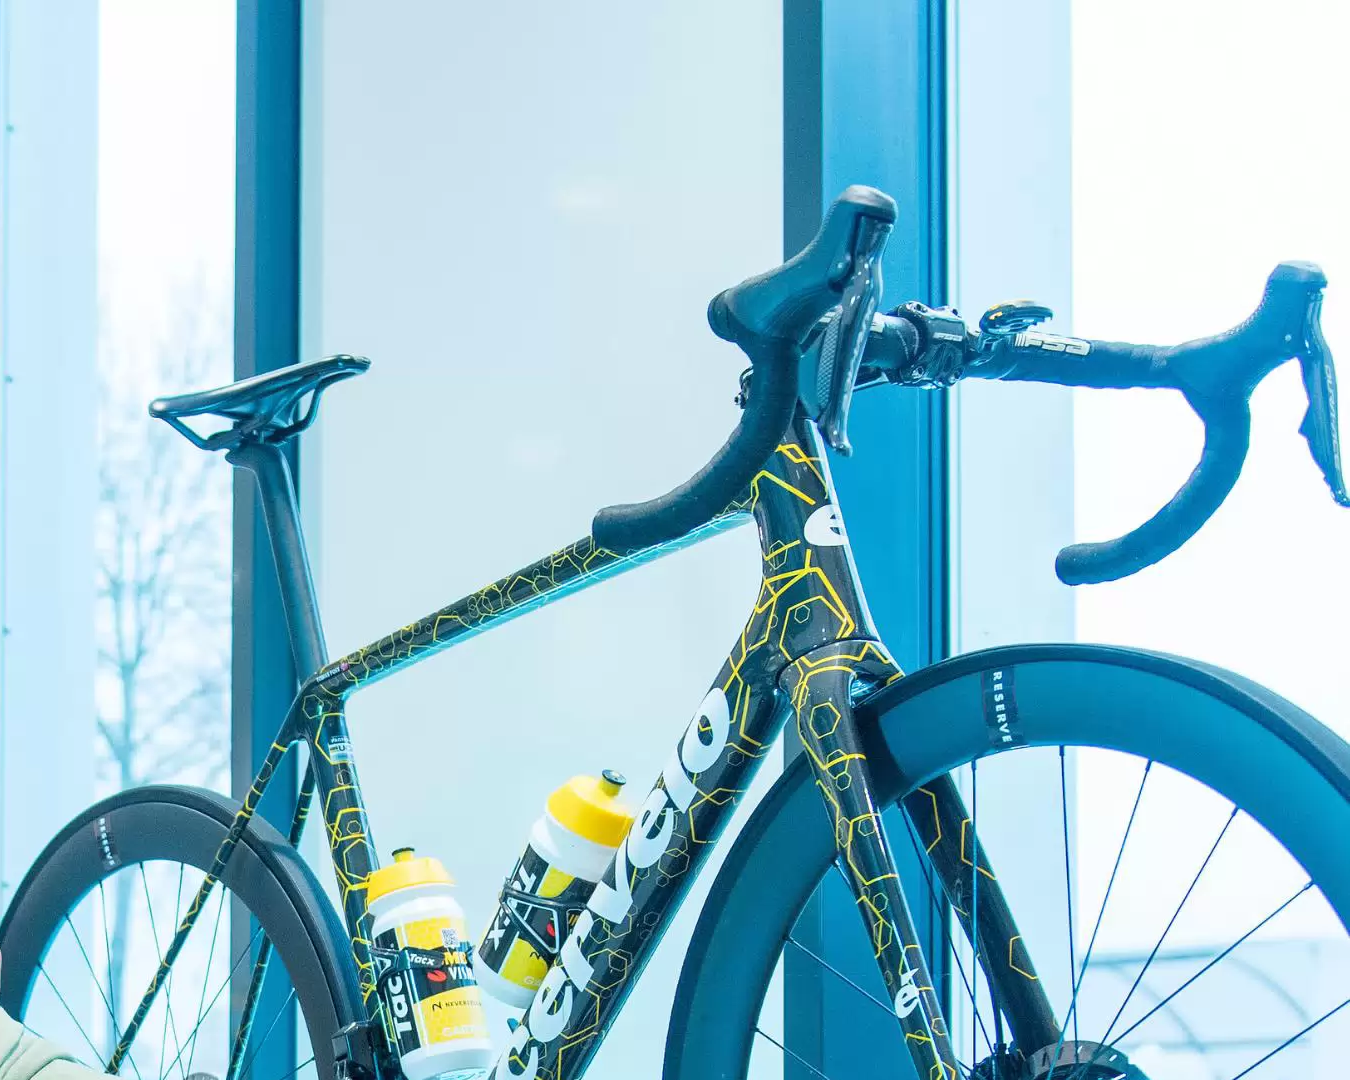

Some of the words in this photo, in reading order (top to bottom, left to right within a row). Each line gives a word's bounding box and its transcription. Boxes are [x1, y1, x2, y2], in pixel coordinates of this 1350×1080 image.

[992, 671, 1013, 743] RESERVE
[410, 953, 435, 966] Tacx
[387, 974, 413, 1041] Tac
